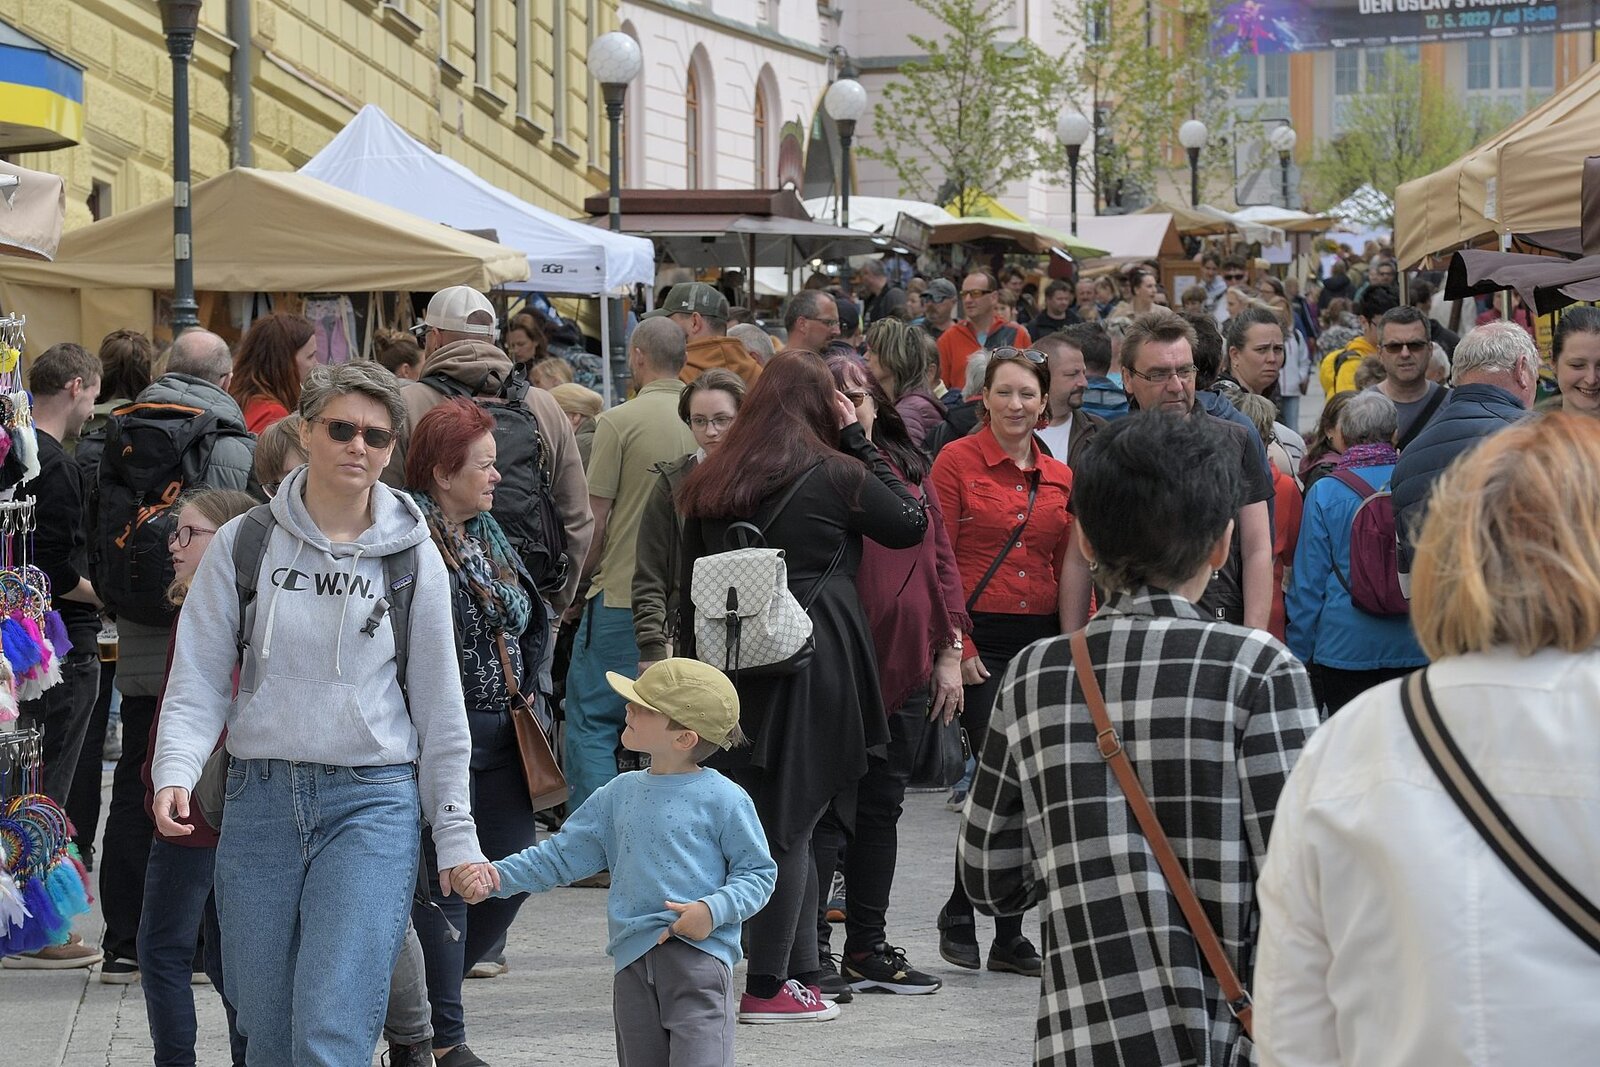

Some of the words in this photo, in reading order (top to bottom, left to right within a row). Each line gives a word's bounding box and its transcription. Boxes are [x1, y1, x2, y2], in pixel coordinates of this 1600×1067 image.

[1359, 0, 1393, 14] DEN
[1425, 14, 1443, 29] 12.
[1444, 13, 1457, 28] 5.
[1459, 11, 1491, 27] 2023
